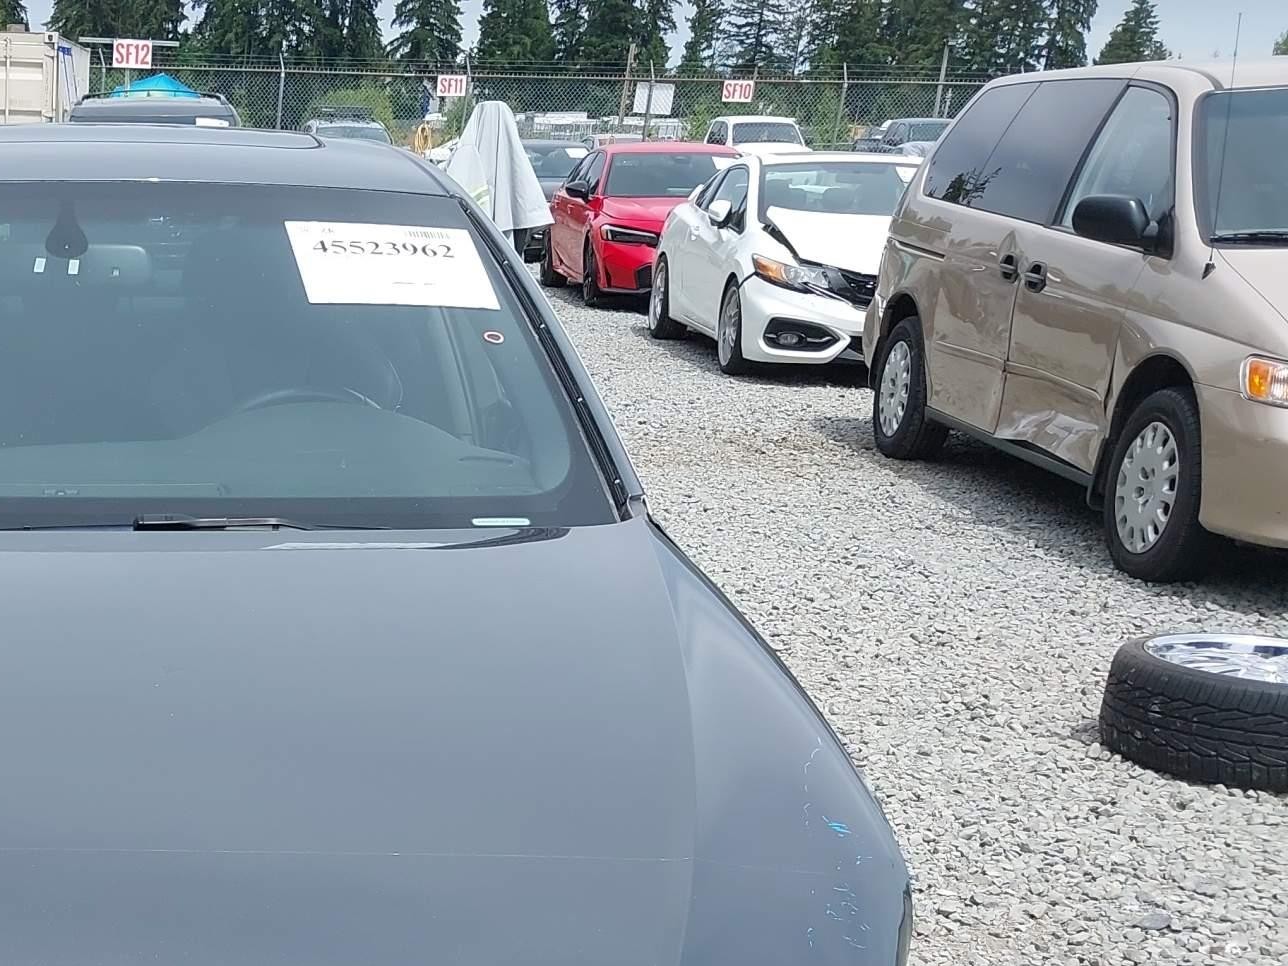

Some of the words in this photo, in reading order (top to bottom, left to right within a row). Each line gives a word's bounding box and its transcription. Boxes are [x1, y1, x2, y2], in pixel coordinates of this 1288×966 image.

[115, 42, 150, 65] SF12
[439, 77, 464, 94] SF11
[723, 82, 752, 100] SF10
[312, 239, 455, 259] 45523962
